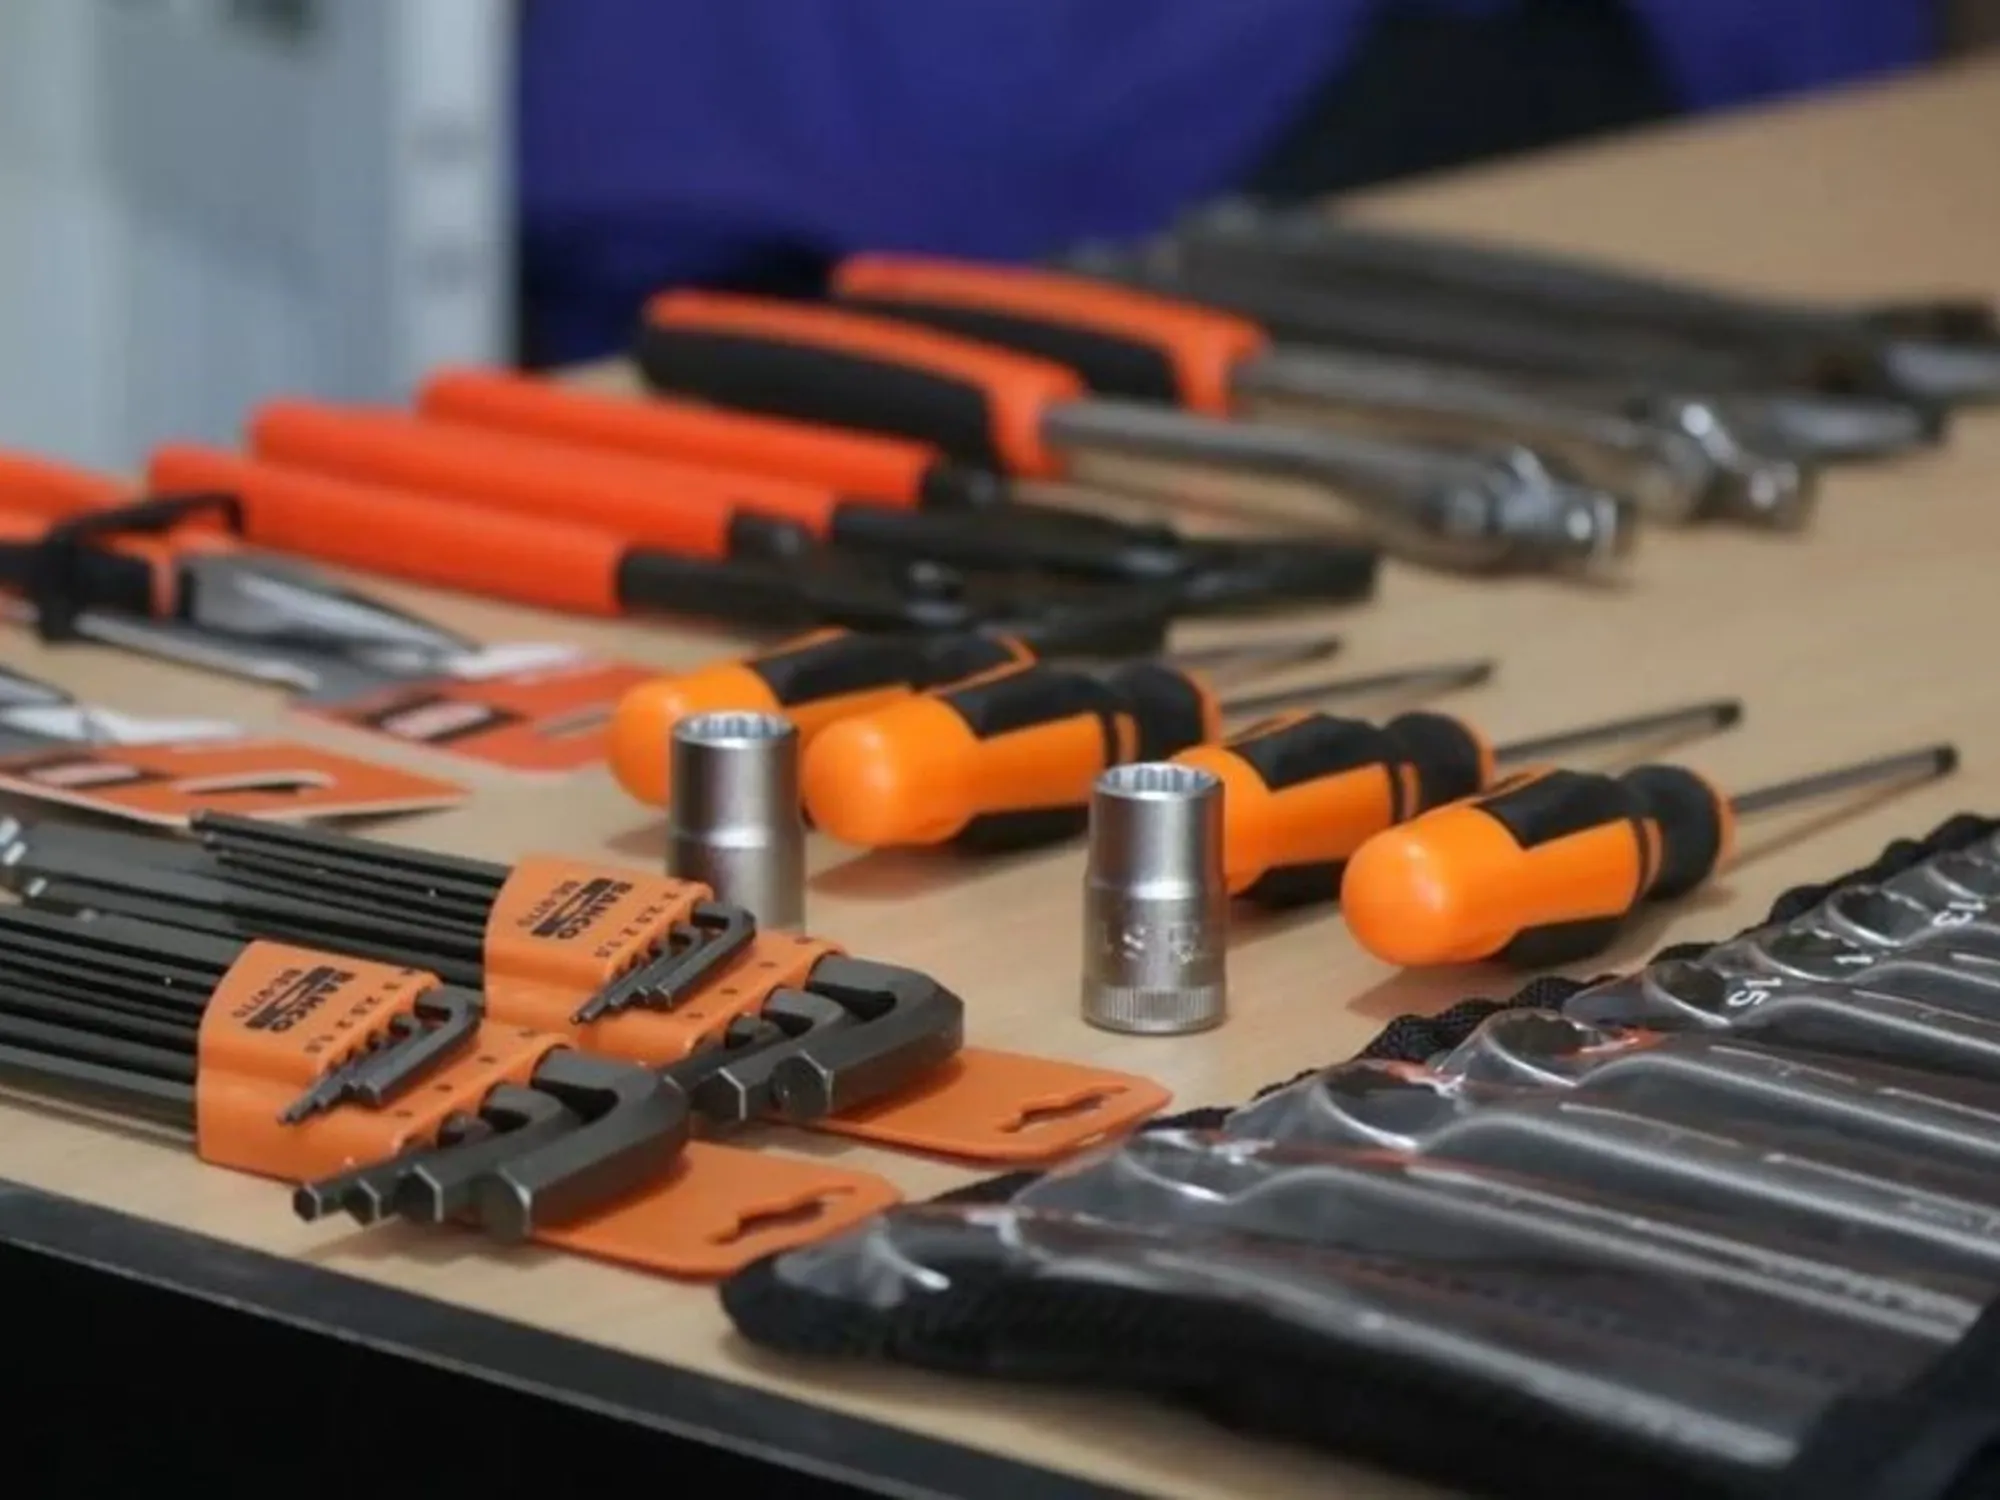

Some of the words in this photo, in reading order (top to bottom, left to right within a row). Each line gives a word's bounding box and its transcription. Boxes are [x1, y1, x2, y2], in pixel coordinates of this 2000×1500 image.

[557, 881, 634, 940] BAHCO
[1932, 900, 1986, 927] 13
[269, 970, 355, 1033] BAHCO
[1727, 976, 1782, 1006] 15
